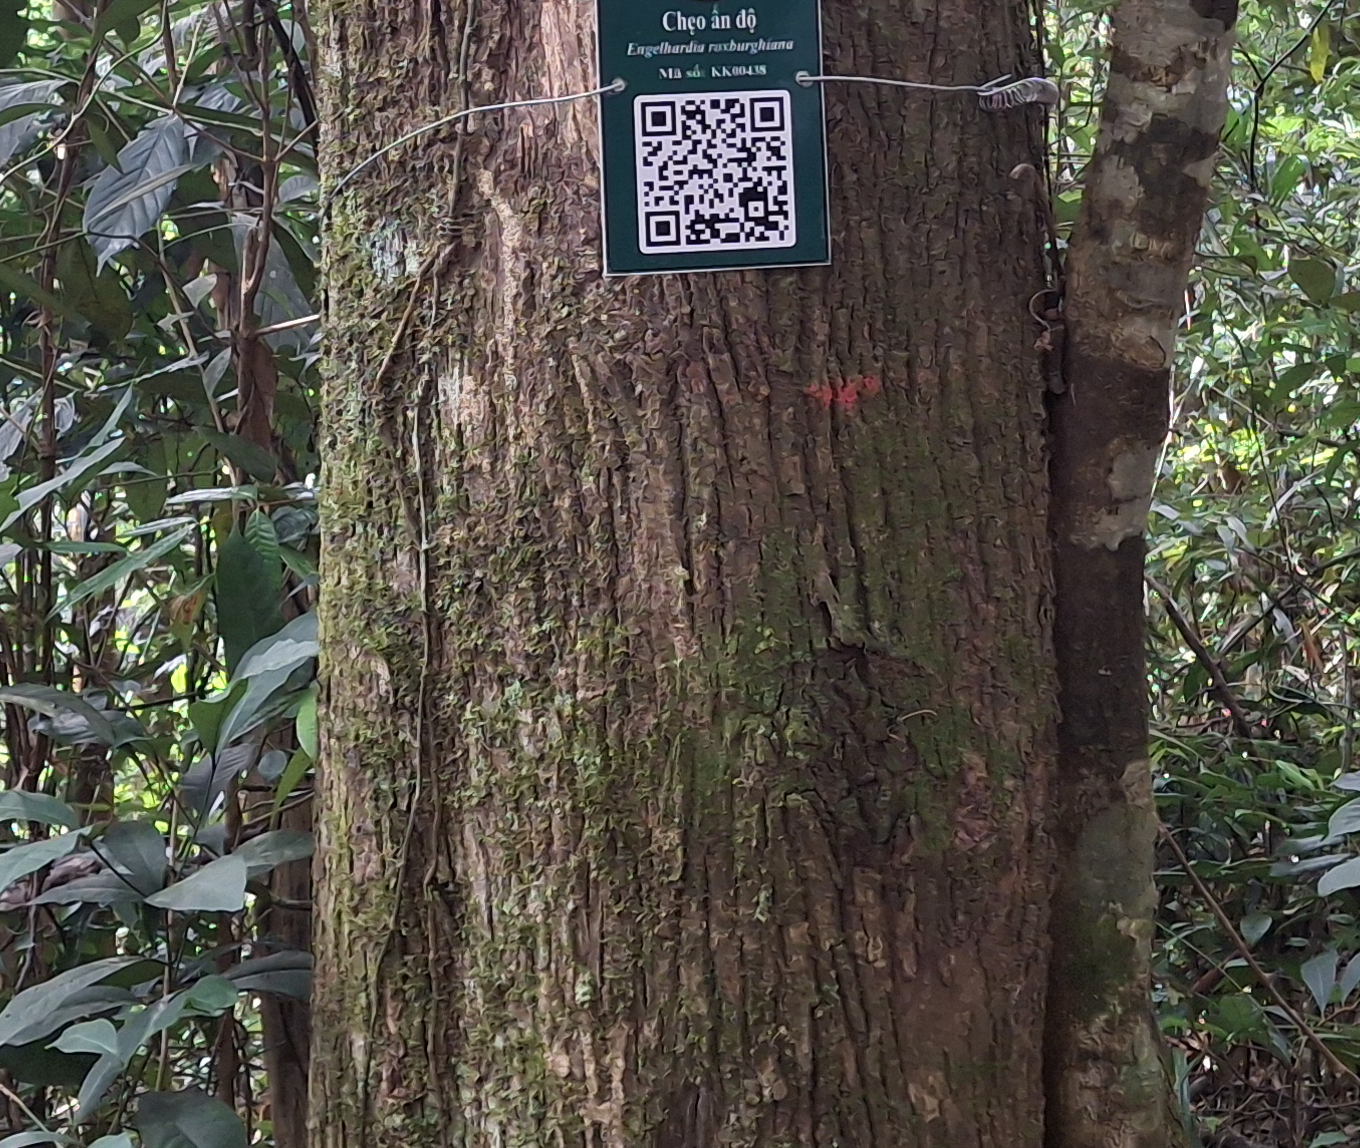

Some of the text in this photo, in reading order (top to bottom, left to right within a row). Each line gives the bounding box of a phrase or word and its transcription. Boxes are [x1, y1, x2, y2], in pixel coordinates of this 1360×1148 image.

[662, 10, 706, 36] Chẹo
[735, 7, 757, 34] độ
[627, 37, 794, 58] Engelhardia roxburghiana
[658, 67, 682, 80] Mã
